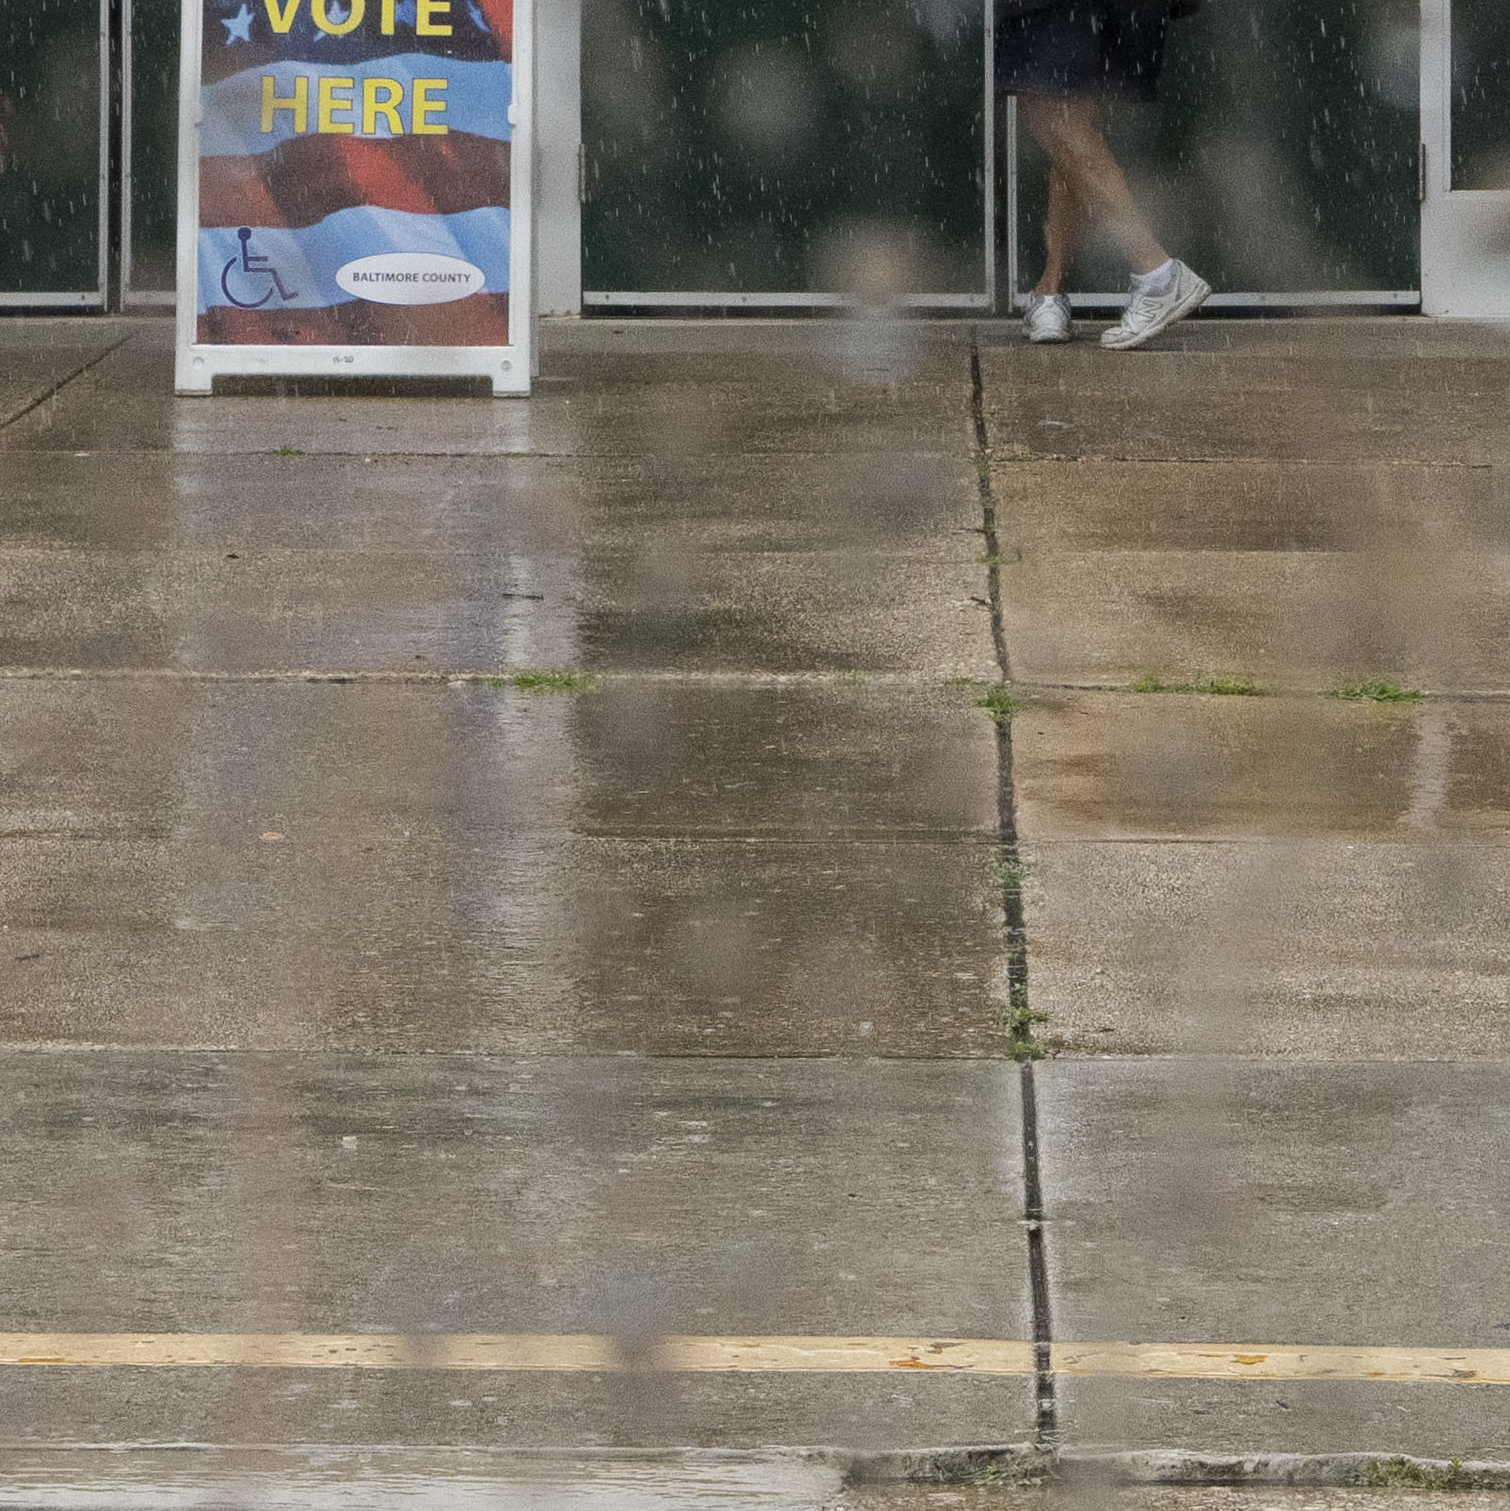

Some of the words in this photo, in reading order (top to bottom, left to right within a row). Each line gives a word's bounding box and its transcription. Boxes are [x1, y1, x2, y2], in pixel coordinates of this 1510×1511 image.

[259, 75, 449, 136] HERE
[352, 272, 419, 283] BALTIMORE
[422, 273, 471, 283] COUNTY
